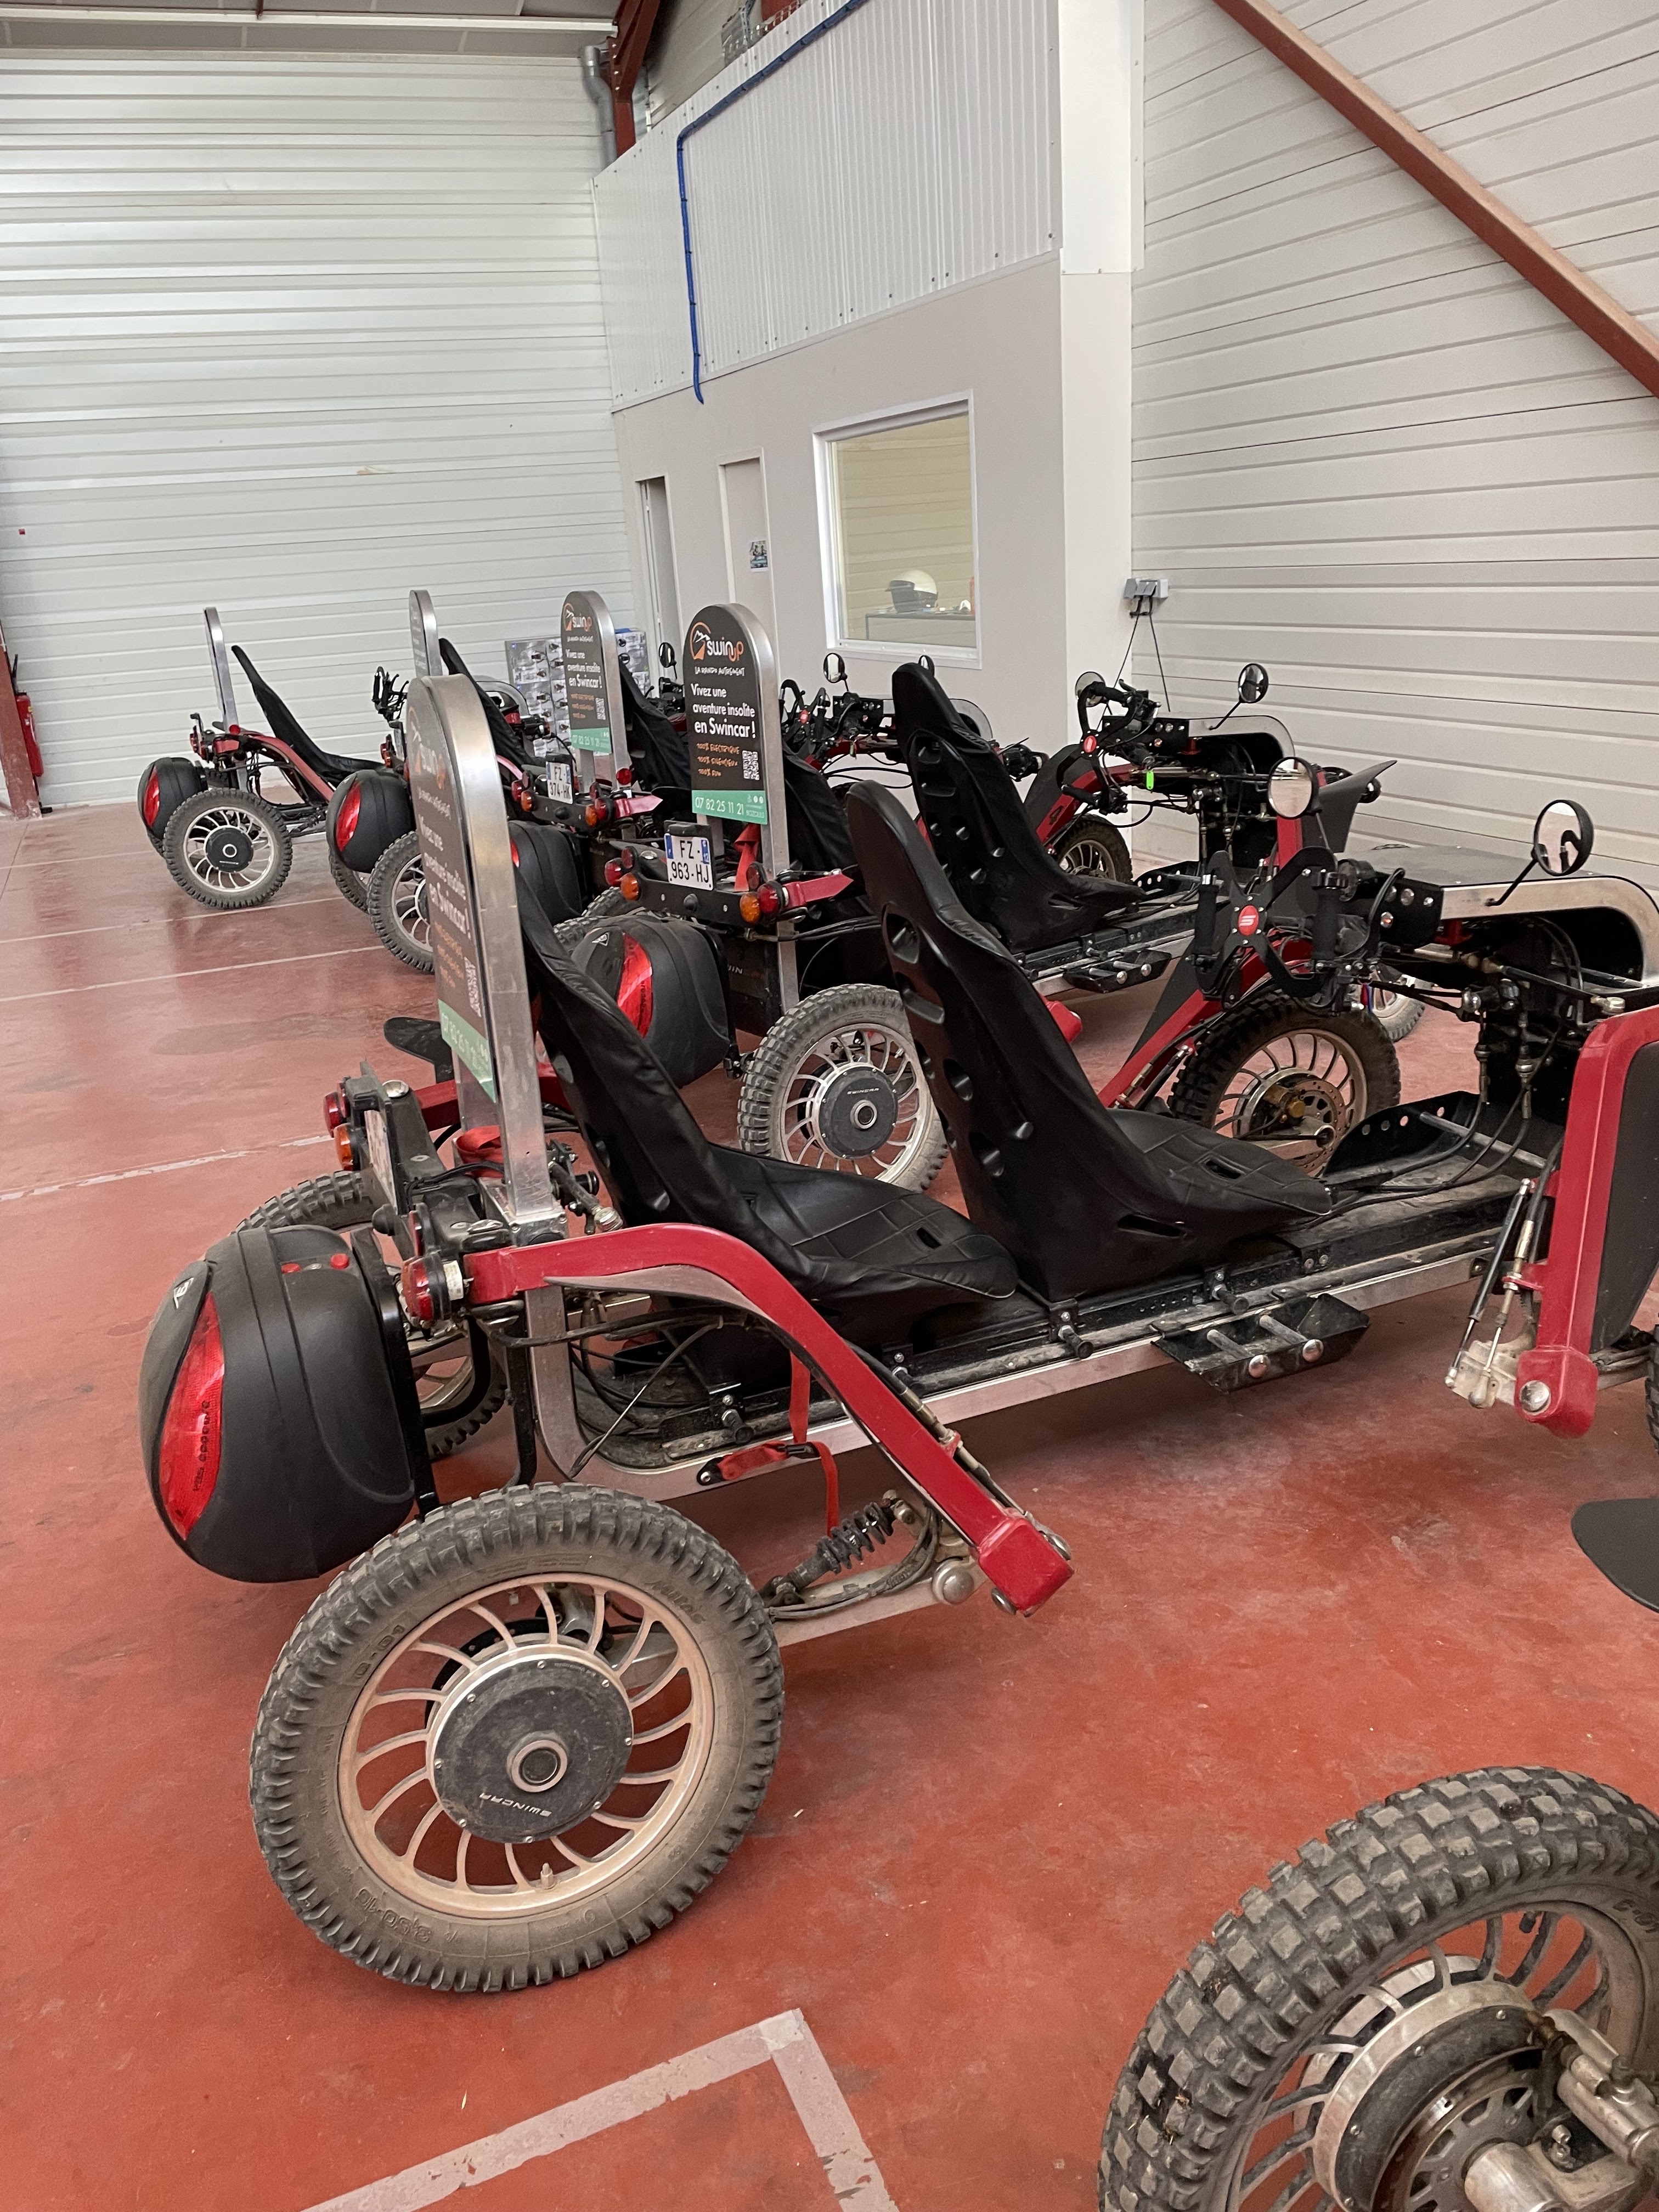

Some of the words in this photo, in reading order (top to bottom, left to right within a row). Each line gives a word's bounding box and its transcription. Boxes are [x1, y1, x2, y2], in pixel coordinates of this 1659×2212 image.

[690, 683, 712, 697] Vivez
[712, 688, 727, 698] une
[692, 703, 727, 715] aventure
[727, 702, 755, 718] insolite
[694, 721, 708, 733] en
[709, 717, 751, 738] Swincar
[695, 797, 704, 809] 07
[706, 798, 715, 810] 82
[716, 800, 726, 812] 25
[727, 802, 734, 814] 11
[736, 803, 744, 815] 21
[671, 861, 709, 883] 963-HJ
[478, 1792, 552, 1818] SWINCAR
